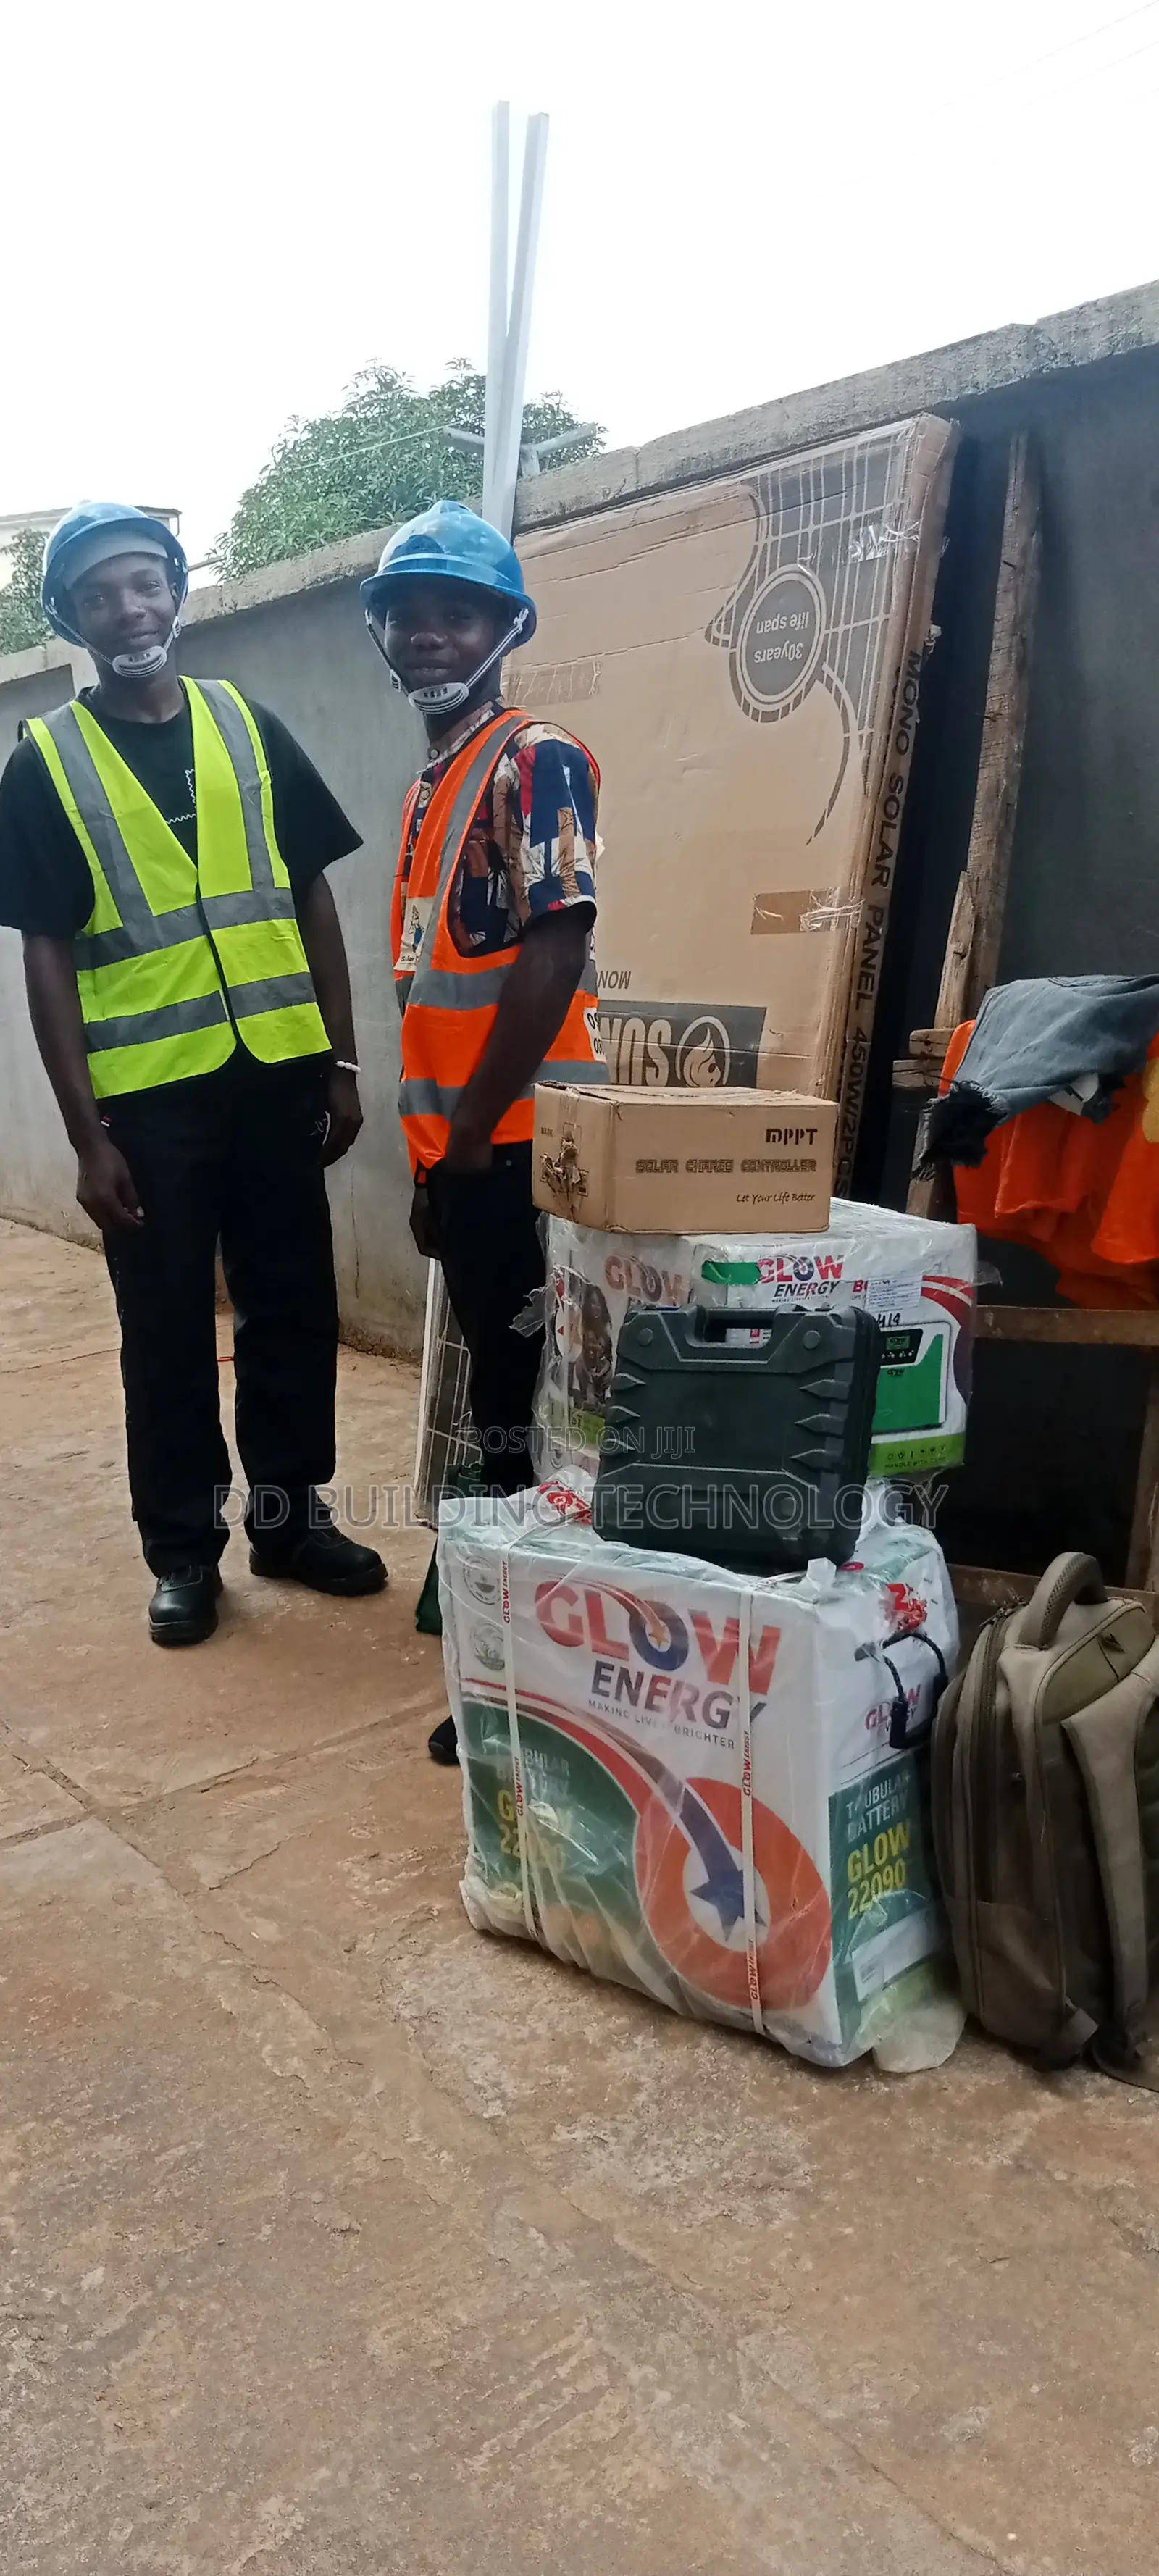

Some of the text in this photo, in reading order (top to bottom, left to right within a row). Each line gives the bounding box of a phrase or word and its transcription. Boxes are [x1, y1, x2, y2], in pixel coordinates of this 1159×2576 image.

[756, 611, 810, 634] life span
[754, 640, 804, 663] 30years
[895, 650, 921, 756] MONO
[871, 772, 904, 888] SOLAR
[855, 904, 886, 1011] PANEL
[598, 971, 632, 990] MON
[635, 1158, 817, 1174] SOLAR CHARGE CONTROLLER
[736, 1192, 816, 1205] Let Your Life Better
[605, 1255, 682, 1306] GLOW
[758, 1254, 844, 1284] GLOW
[774, 1281, 841, 1298] ENERGY
[501, 1588, 511, 1623] GLOW
[535, 1580, 782, 1696] GLOW
[588, 1698, 630, 1720] MAKING
[674, 1725, 735, 1750] BRIGHTER
[742, 1758, 752, 1797] GLOW
[846, 1819, 911, 1883] GLOW
[847, 1857, 907, 1921] 22090
[748, 1964, 759, 2001] GLOW
